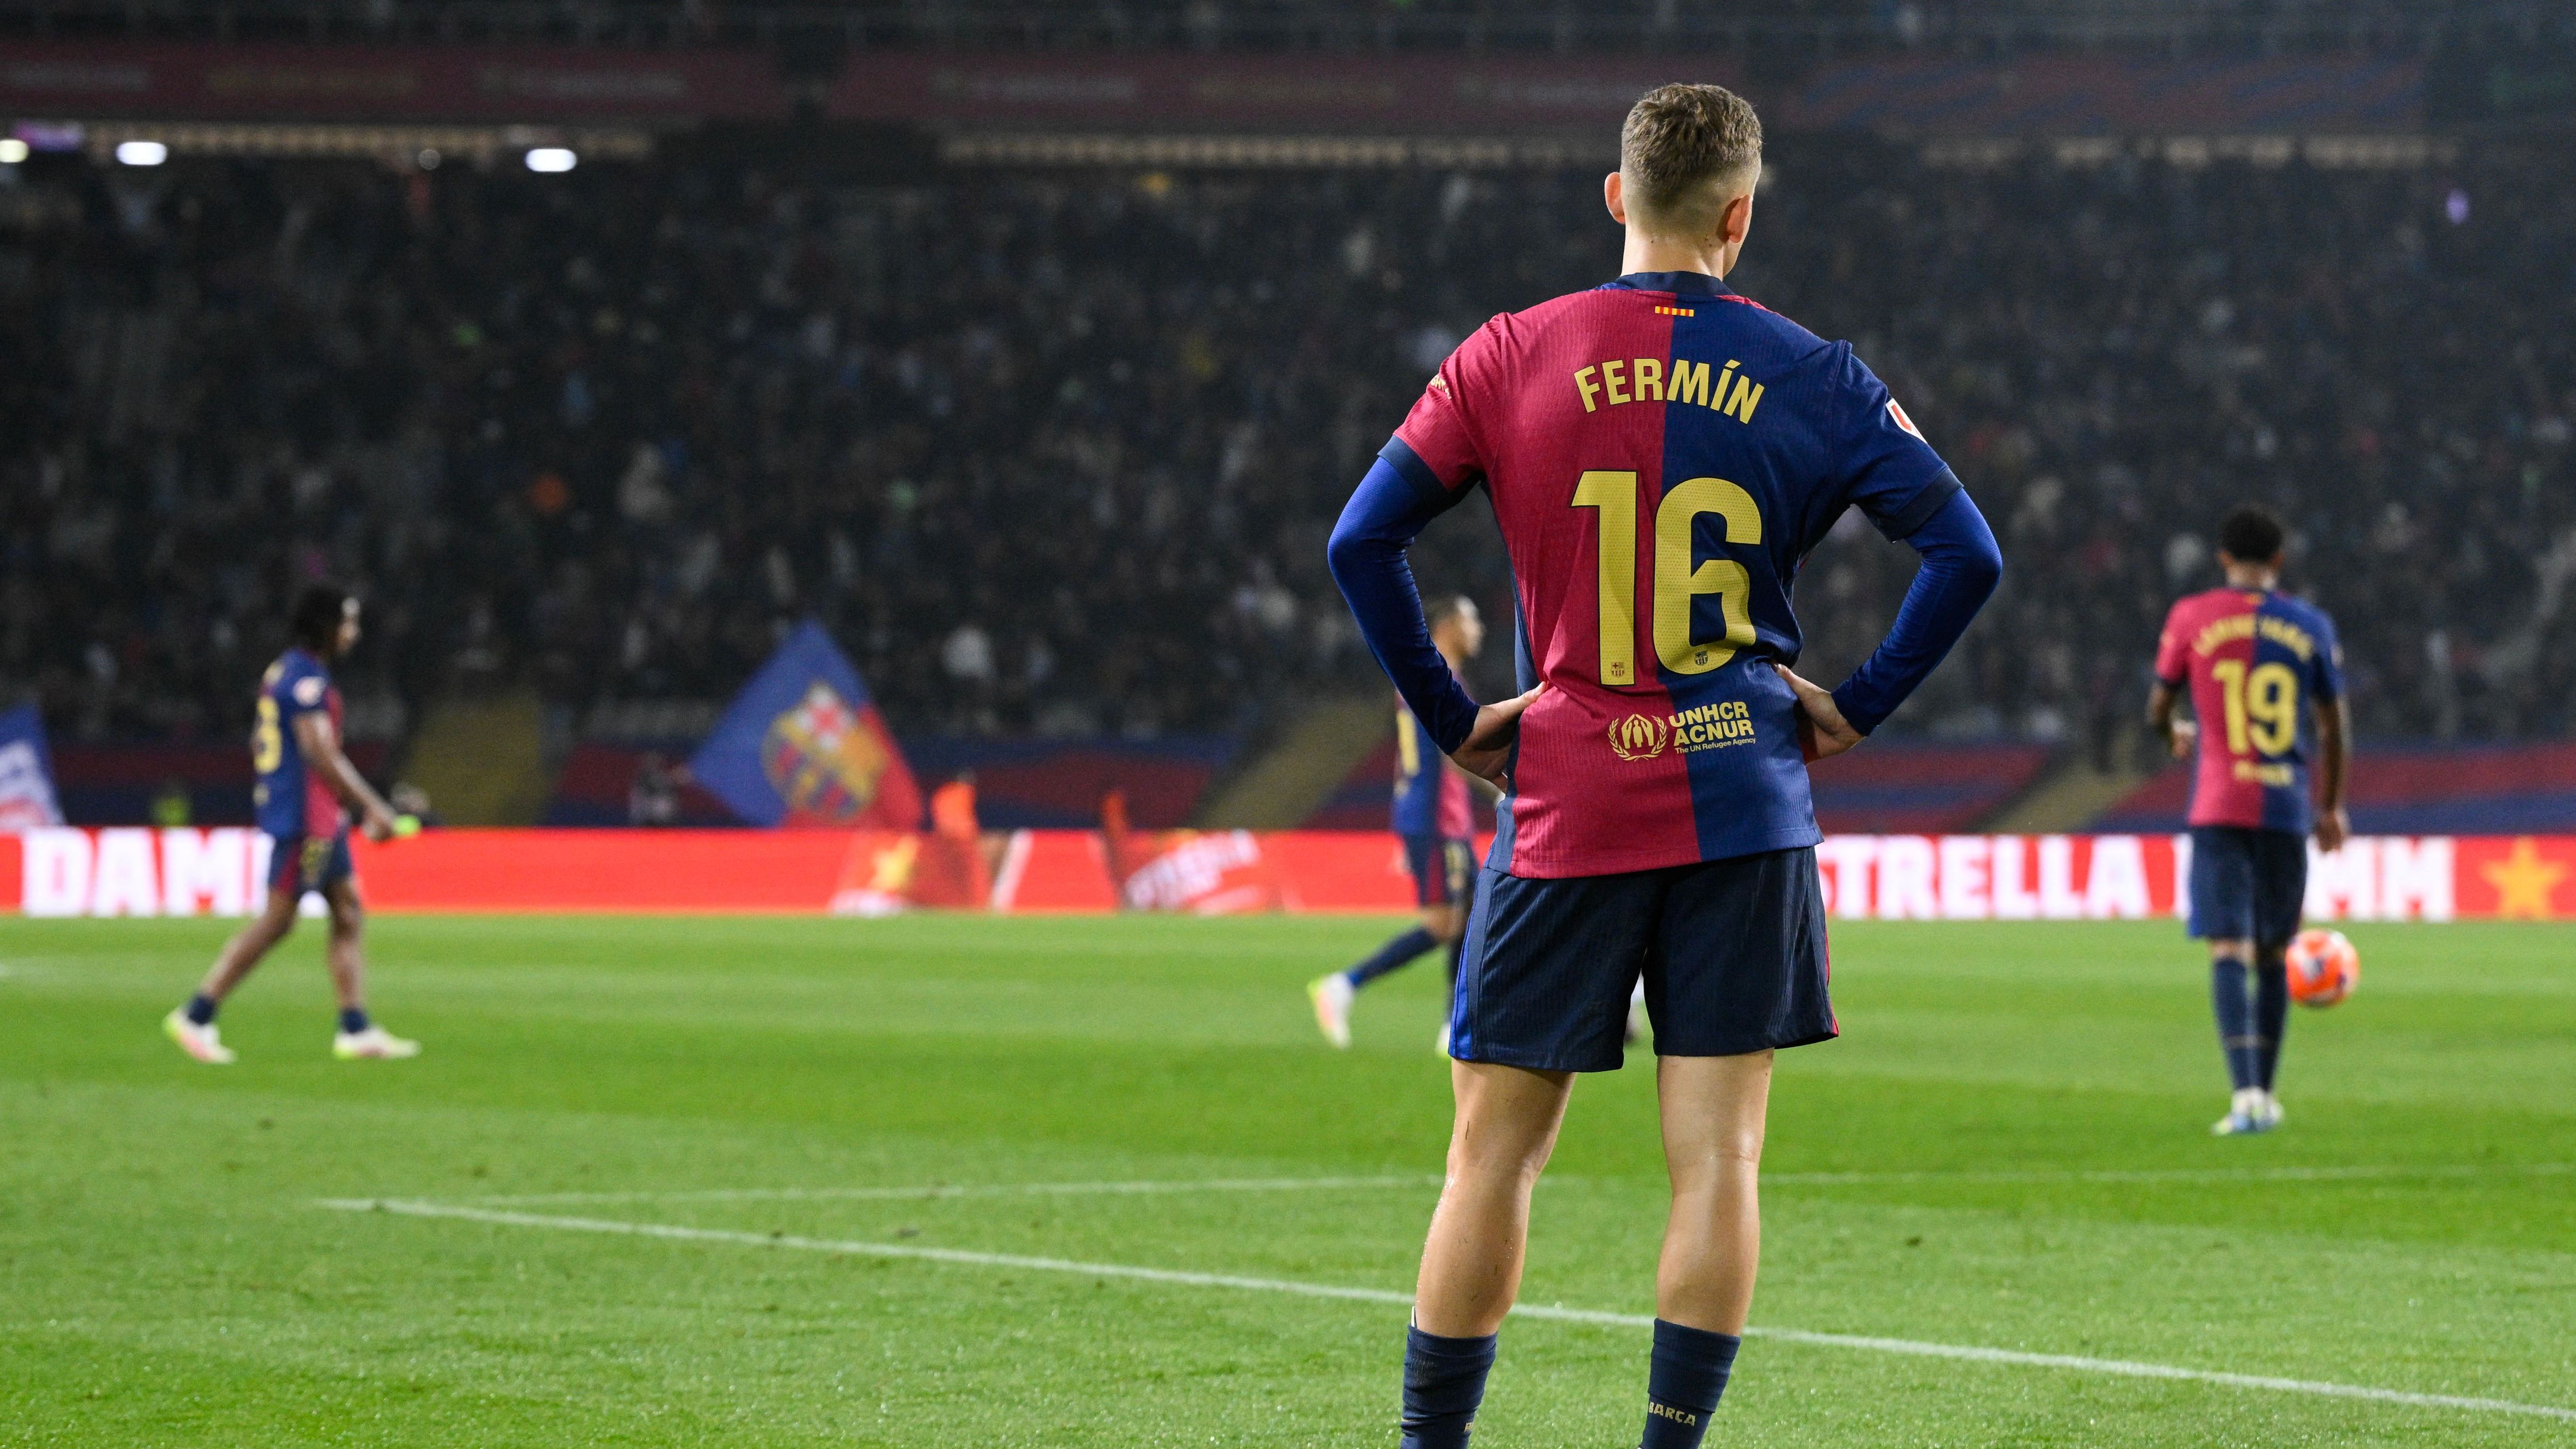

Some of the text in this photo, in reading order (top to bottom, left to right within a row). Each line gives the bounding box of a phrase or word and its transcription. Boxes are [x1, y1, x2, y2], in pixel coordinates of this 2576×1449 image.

[1573, 358, 1765, 425] FERMÍN
[1570, 470, 1762, 686] 16
[1669, 701, 1749, 727] UNHCR
[2212, 659, 2299, 756] 19
[1673, 719, 1755, 746] ACNUR
[1702, 741, 1731, 750] Refugee
[1732, 738, 1756, 746] Agency
[2174, 834, 2456, 920] MM
[1649, 1402, 1696, 1426] BARÇA
